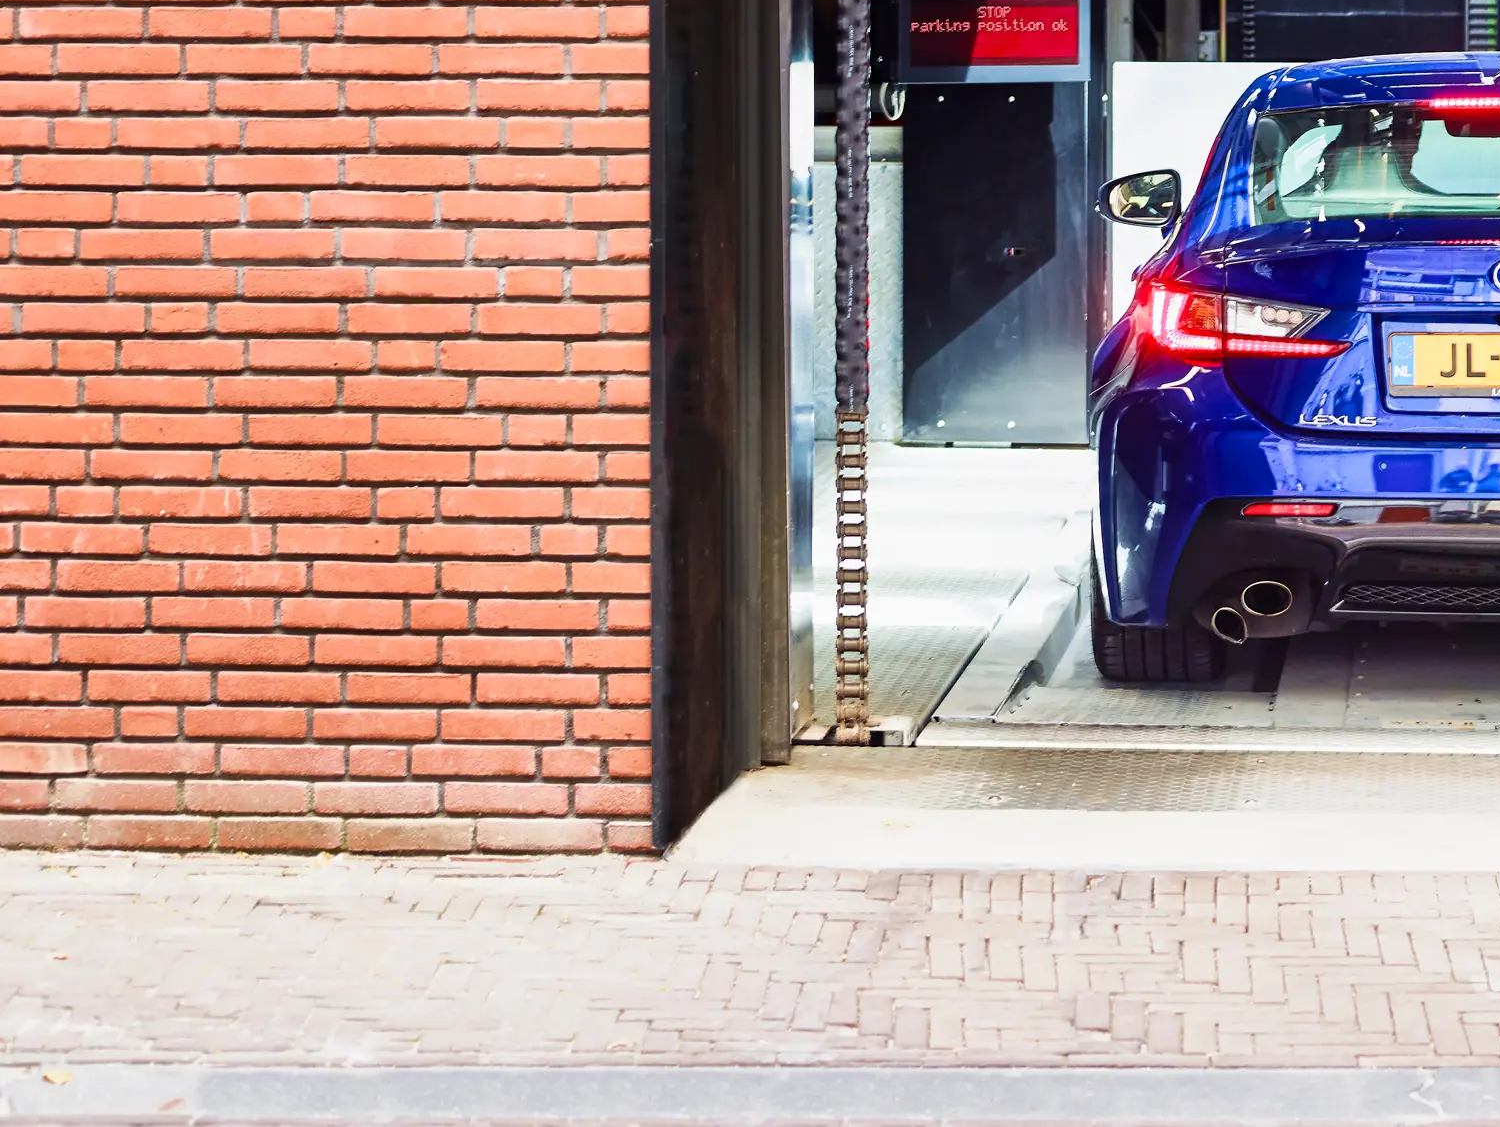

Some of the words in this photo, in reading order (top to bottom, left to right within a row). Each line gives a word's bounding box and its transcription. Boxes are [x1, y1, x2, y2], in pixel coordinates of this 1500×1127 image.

[976, 5, 1012, 19] STOP
[1051, 19, 1069, 32] ok
[1394, 365, 1412, 377] NL
[1299, 413, 1377, 427] LEXUS
